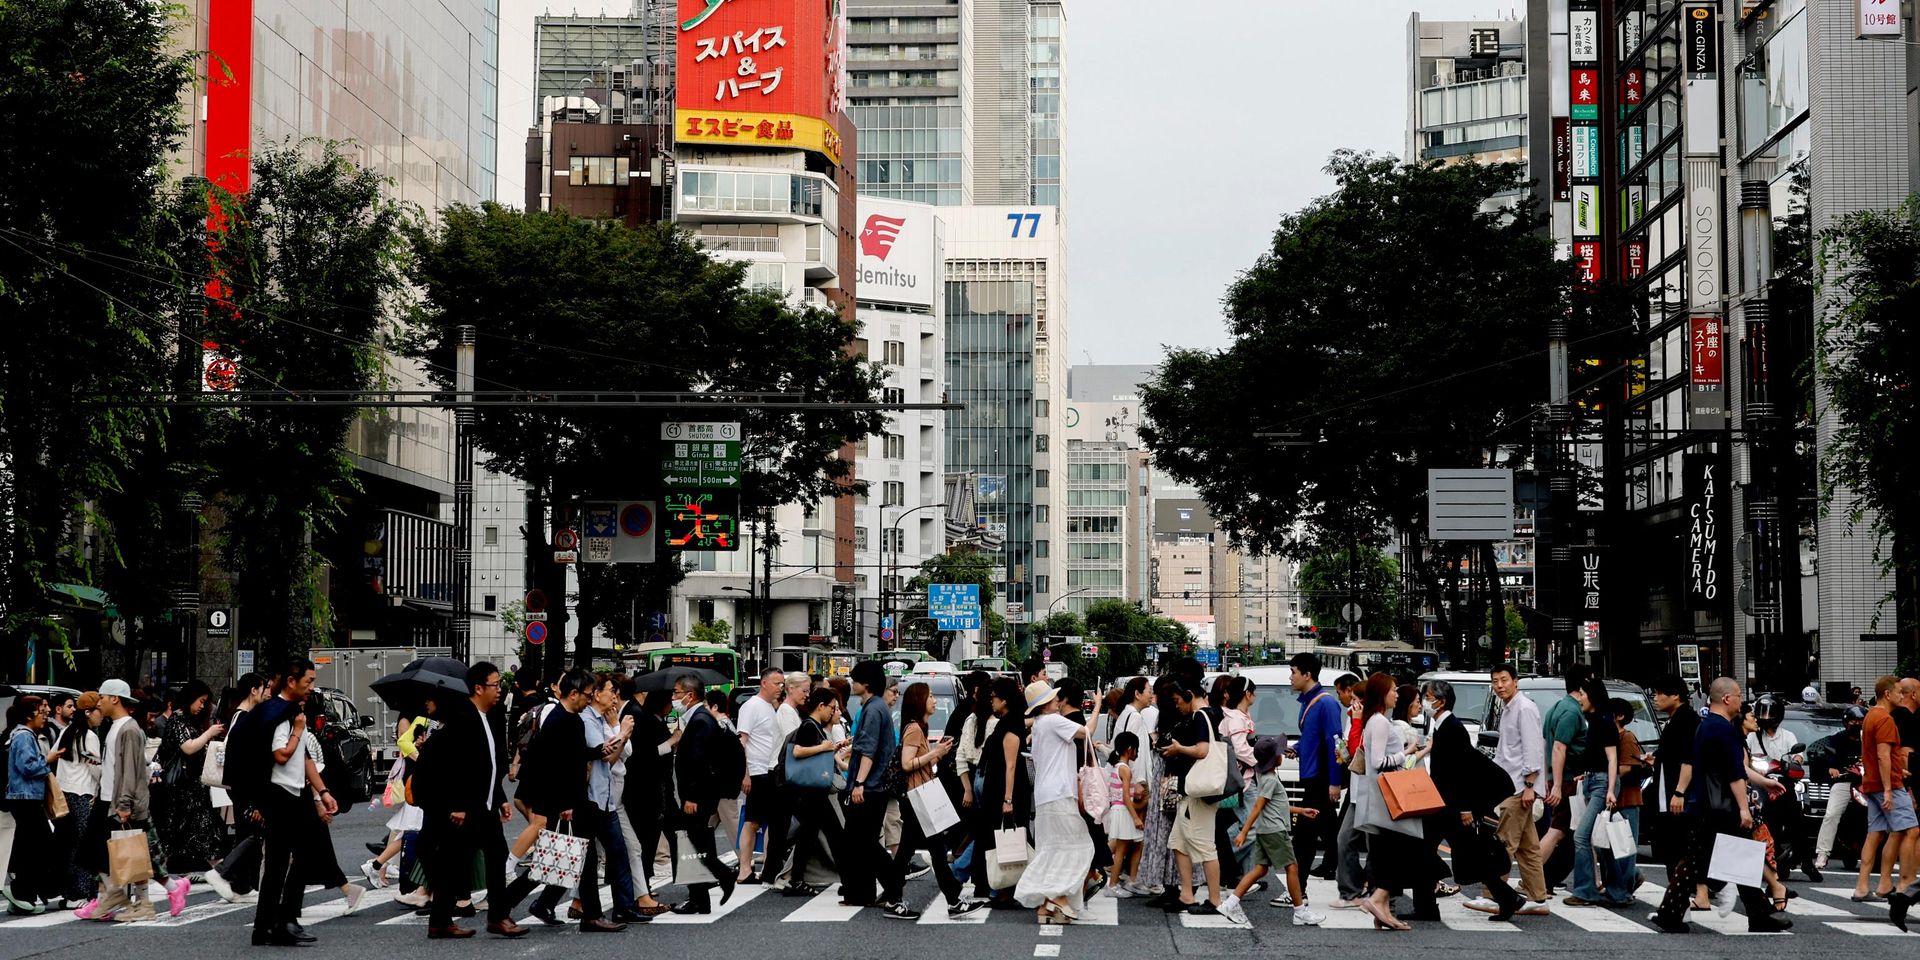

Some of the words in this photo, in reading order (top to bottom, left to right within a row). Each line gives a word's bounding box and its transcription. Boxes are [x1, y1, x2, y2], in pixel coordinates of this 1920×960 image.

[1583, 17, 1593, 54] カツミ堂
[1864, 13, 1896, 25] 10号館
[695, 26, 787, 62] スパイス
[1696, 36, 1705, 71] GINZA
[715, 66, 784, 101] ハーブ
[737, 56, 757, 76] &
[687, 117, 794, 140] エスビー食品
[1576, 128, 1584, 175] 銀座コクリコ
[1589, 138, 1597, 175] Coquelicot
[1007, 213, 1041, 238] 77
[1696, 206, 1713, 296] SONOKO
[1695, 330, 1704, 375] ステーキ
[1706, 322, 1718, 357] 銀座の
[669, 426, 678, 435] C1
[722, 426, 732, 435] C1
[1690, 503, 1702, 593] CAMERA
[1703, 465, 1716, 599] KATSUMIDO
[1583, 553, 1600, 608] 山形屋
